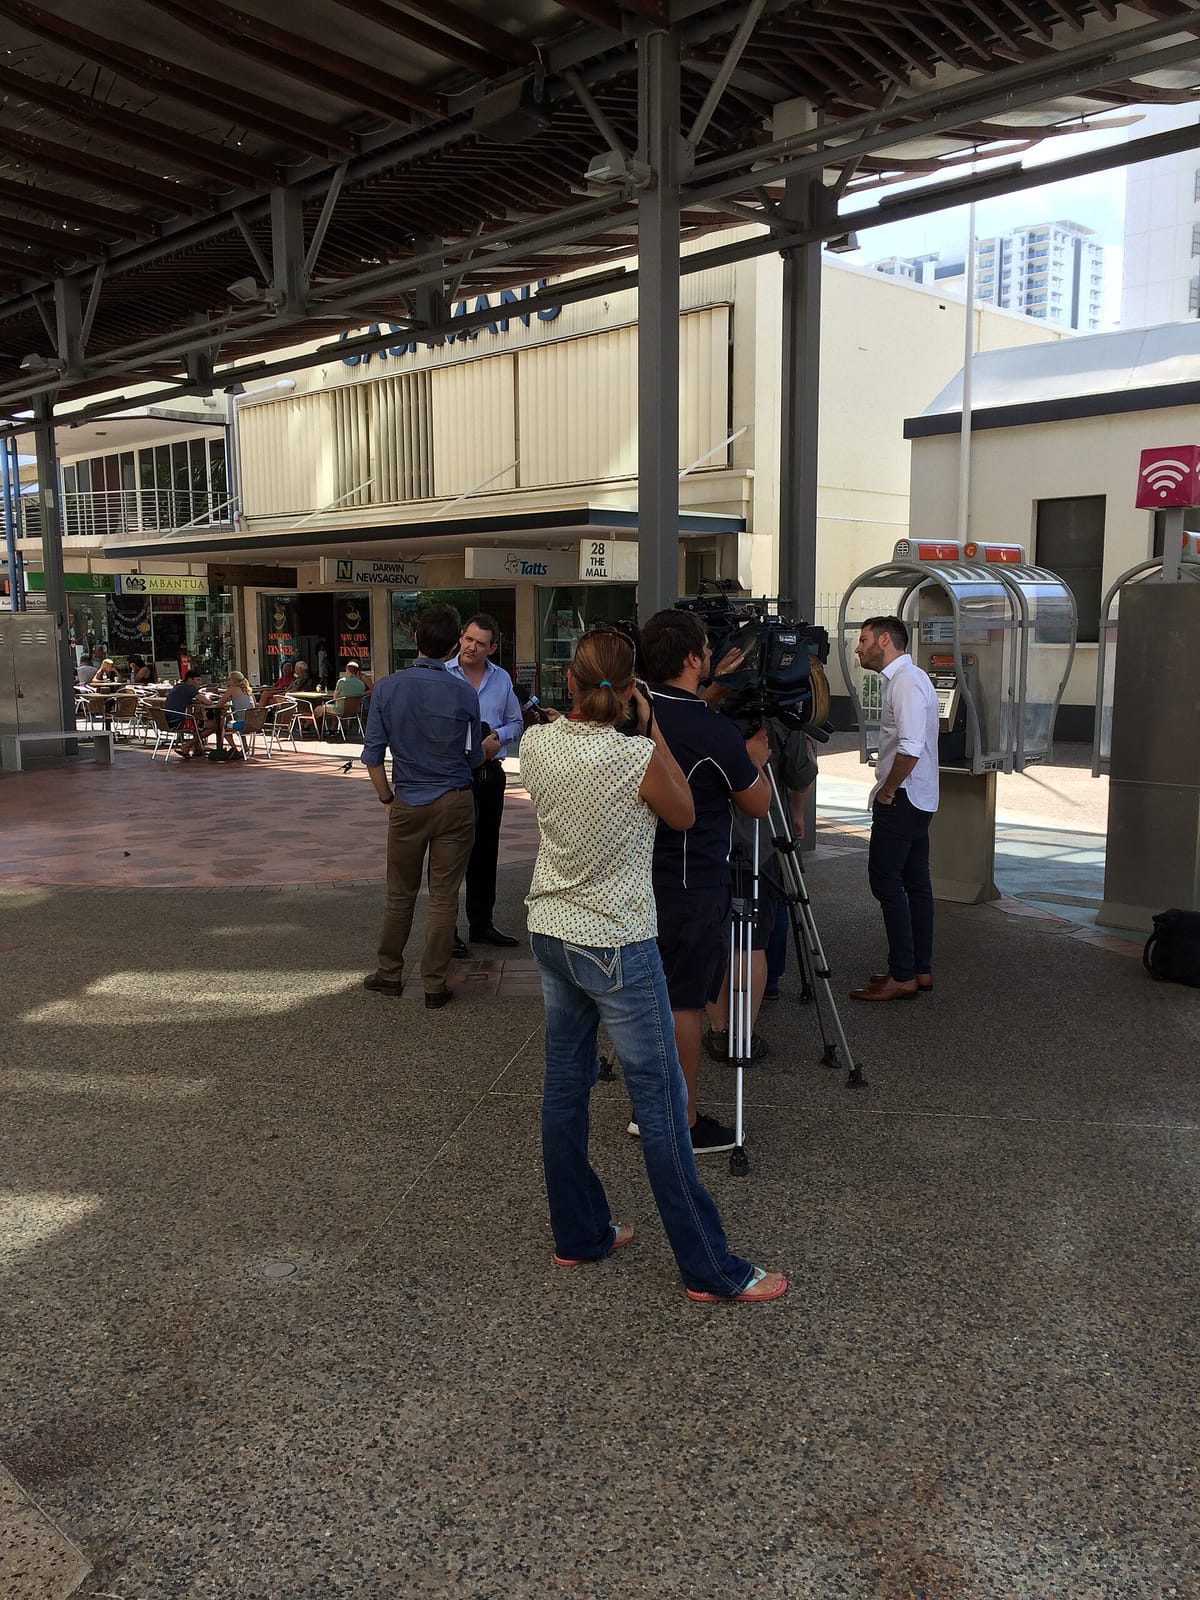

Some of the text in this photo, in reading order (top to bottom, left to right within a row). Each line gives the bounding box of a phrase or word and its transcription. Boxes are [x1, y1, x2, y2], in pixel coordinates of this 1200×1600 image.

[591, 542, 605, 555] 28
[590, 557, 605, 566] THE
[373, 563, 404, 573] DARWIN
[520, 561, 548, 575] Tatts
[585, 568, 608, 578] MALL
[356, 572, 419, 584] NEWSAGENCY
[149, 579, 205, 590] MBANTUA
[340, 633, 368, 641] NOW OPEN
[339, 646, 369, 657] DINNER
